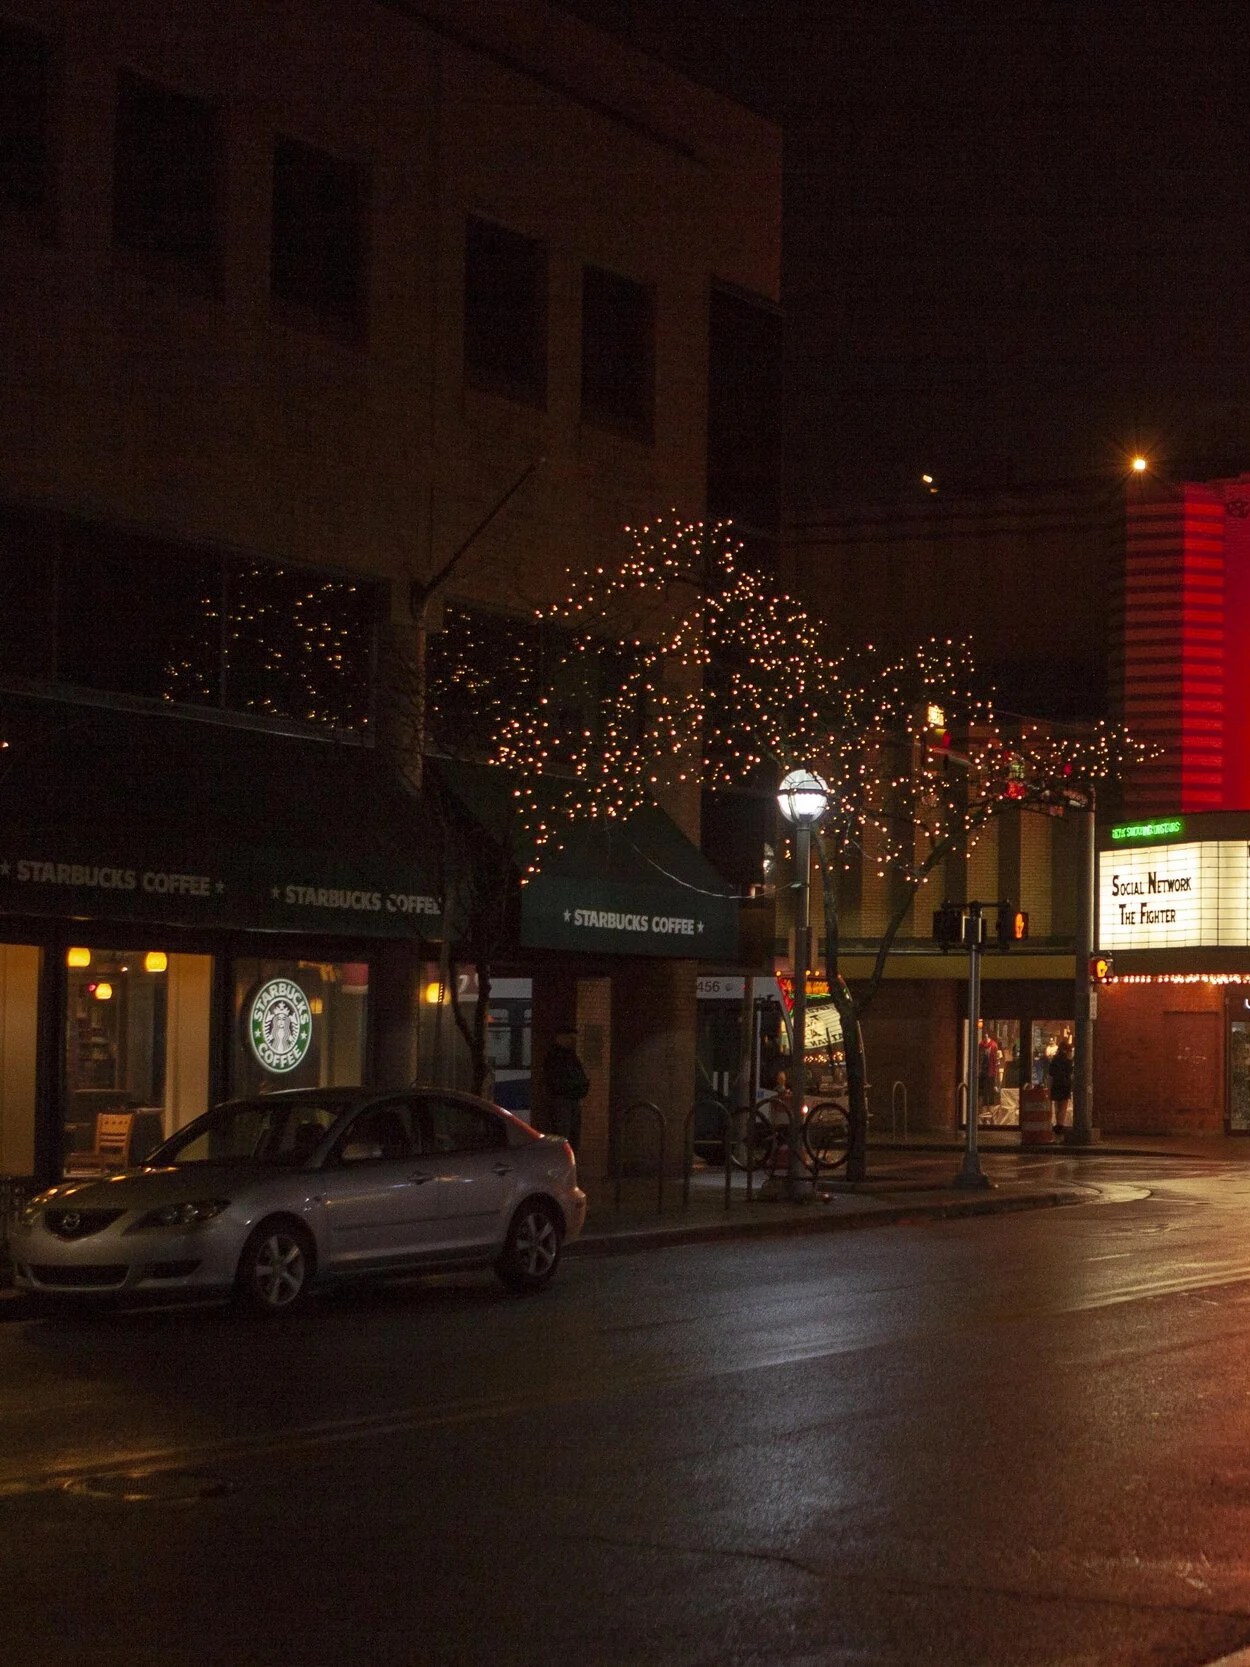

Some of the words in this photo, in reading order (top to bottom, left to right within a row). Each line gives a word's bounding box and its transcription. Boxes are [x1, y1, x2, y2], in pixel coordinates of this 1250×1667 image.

[16, 859, 136, 890] STARBUCKS
[142, 872, 211, 897] COFFEE
[285, 885, 382, 912] STARBUCKS
[573, 908, 649, 932] STARBUCKS
[652, 916, 695, 935] COFFEE
[254, 983, 309, 1025] STARBUCKS
[258, 1043, 302, 1068] COFFEE
